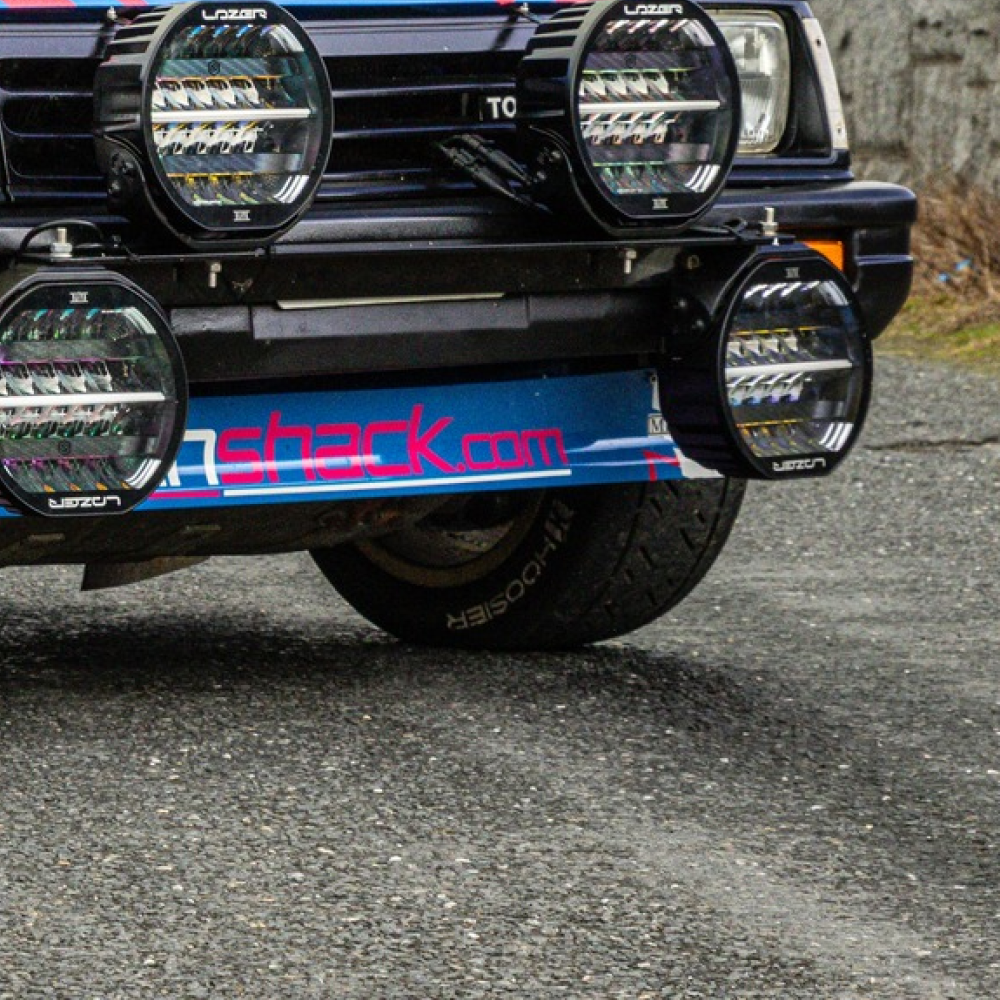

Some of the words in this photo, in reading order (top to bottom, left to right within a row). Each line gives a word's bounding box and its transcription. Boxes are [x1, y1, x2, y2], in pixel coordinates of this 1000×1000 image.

[202, 8, 268, 21] LAZER
[623, 3, 684, 16] LAZER
[159, 404, 568, 488] nshack.com
[446, 536, 558, 631] HOOSIER
